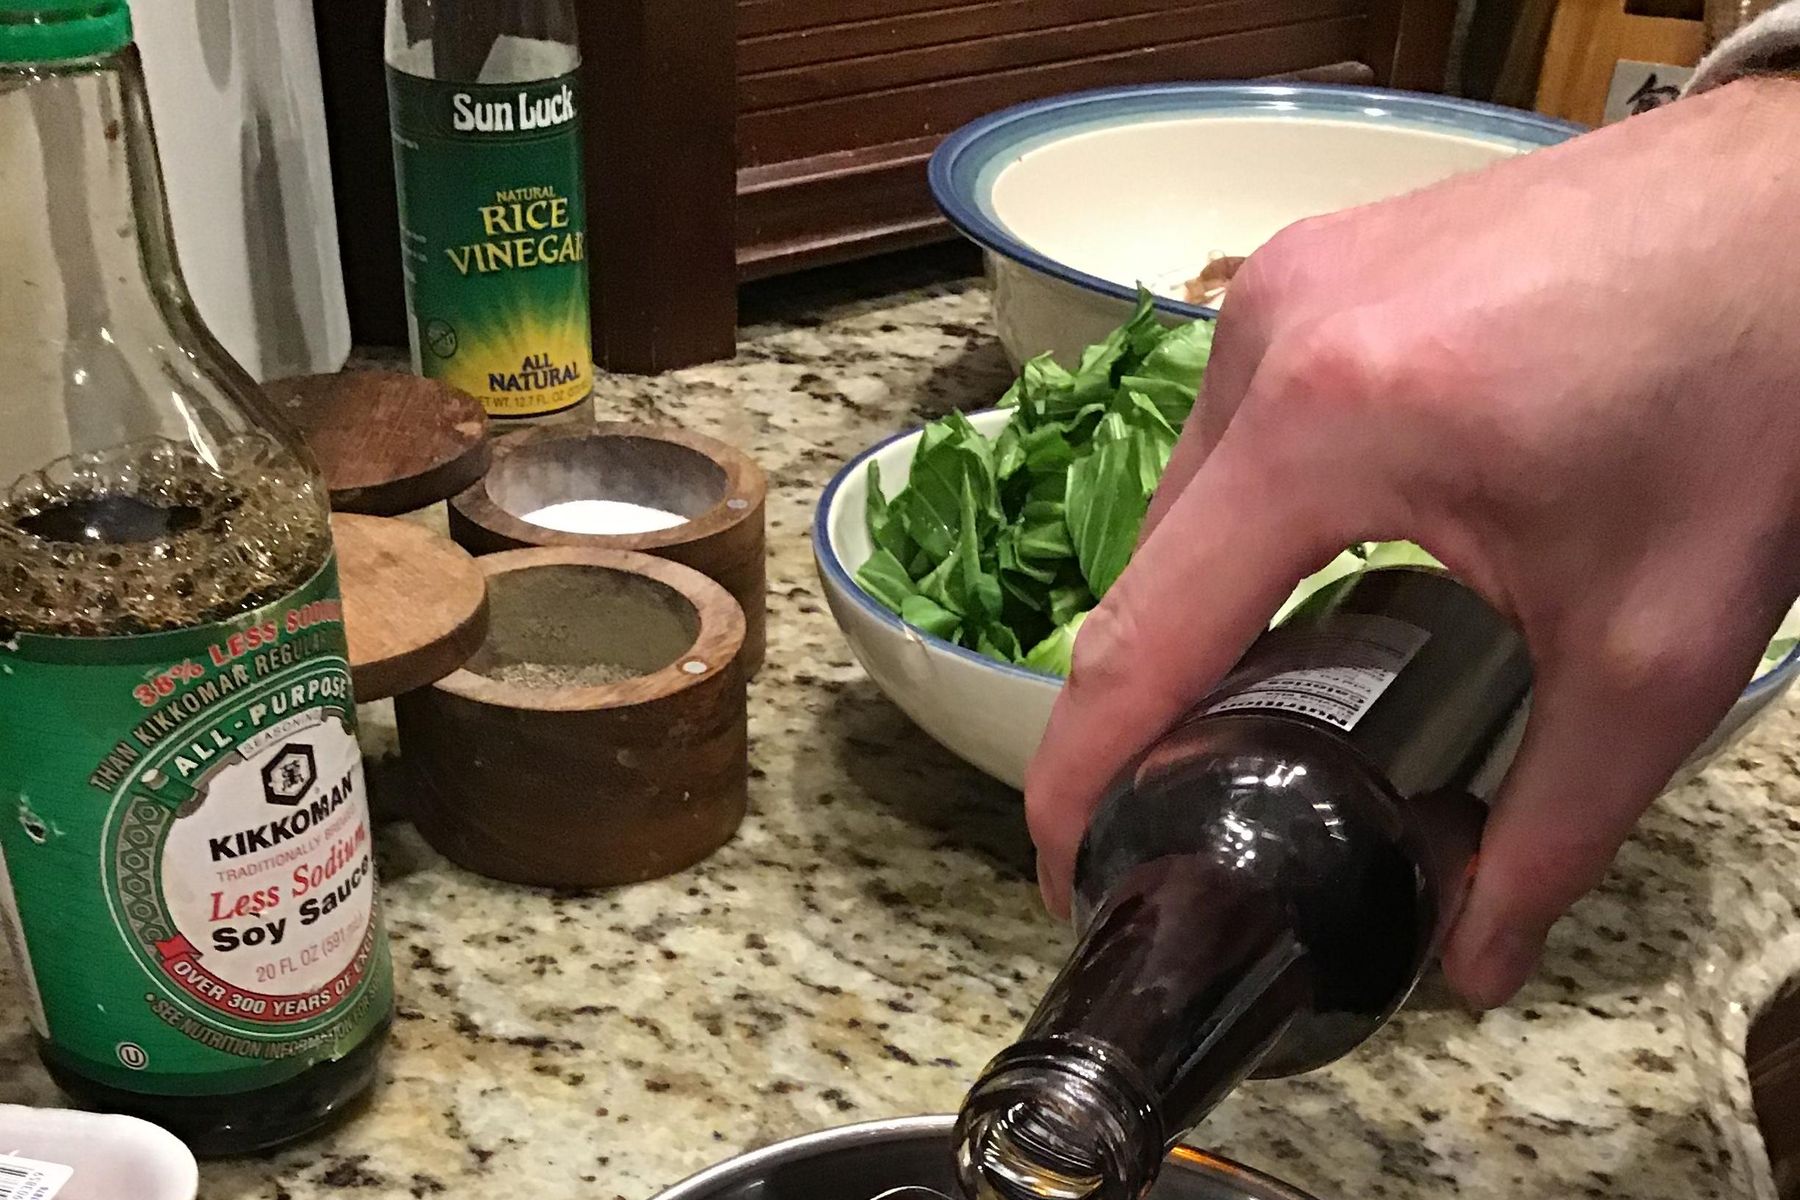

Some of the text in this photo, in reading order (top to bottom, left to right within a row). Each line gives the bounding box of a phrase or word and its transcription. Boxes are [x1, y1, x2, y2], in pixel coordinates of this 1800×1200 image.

[453, 85, 575, 132] Sun Luck
[479, 197, 569, 236] RICE
[496, 186, 556, 201] NATURAL
[488, 362, 580, 391] NATURAL
[522, 353, 553, 371] ALL
[133, 658, 205, 707] 38%
[208, 620, 278, 667] LESS
[89, 741, 140, 793] THAN
[208, 770, 353, 862] KIKKOMAN
[208, 821, 366, 922] Less Sodium
[216, 833, 321, 883] TRADITIONALLY
[211, 853, 369, 952] Soy Sauce
[173, 960, 226, 1002] OVER
[227, 992, 266, 1015] 300
[272, 991, 331, 1017] YEARS
[334, 971, 355, 996] OF
[256, 963, 276, 983] 20
[279, 954, 298, 974] FL
[300, 944, 321, 968] OZ
[152, 999, 184, 1023] SEE
[181, 1015, 262, 1058] NUTRITION
